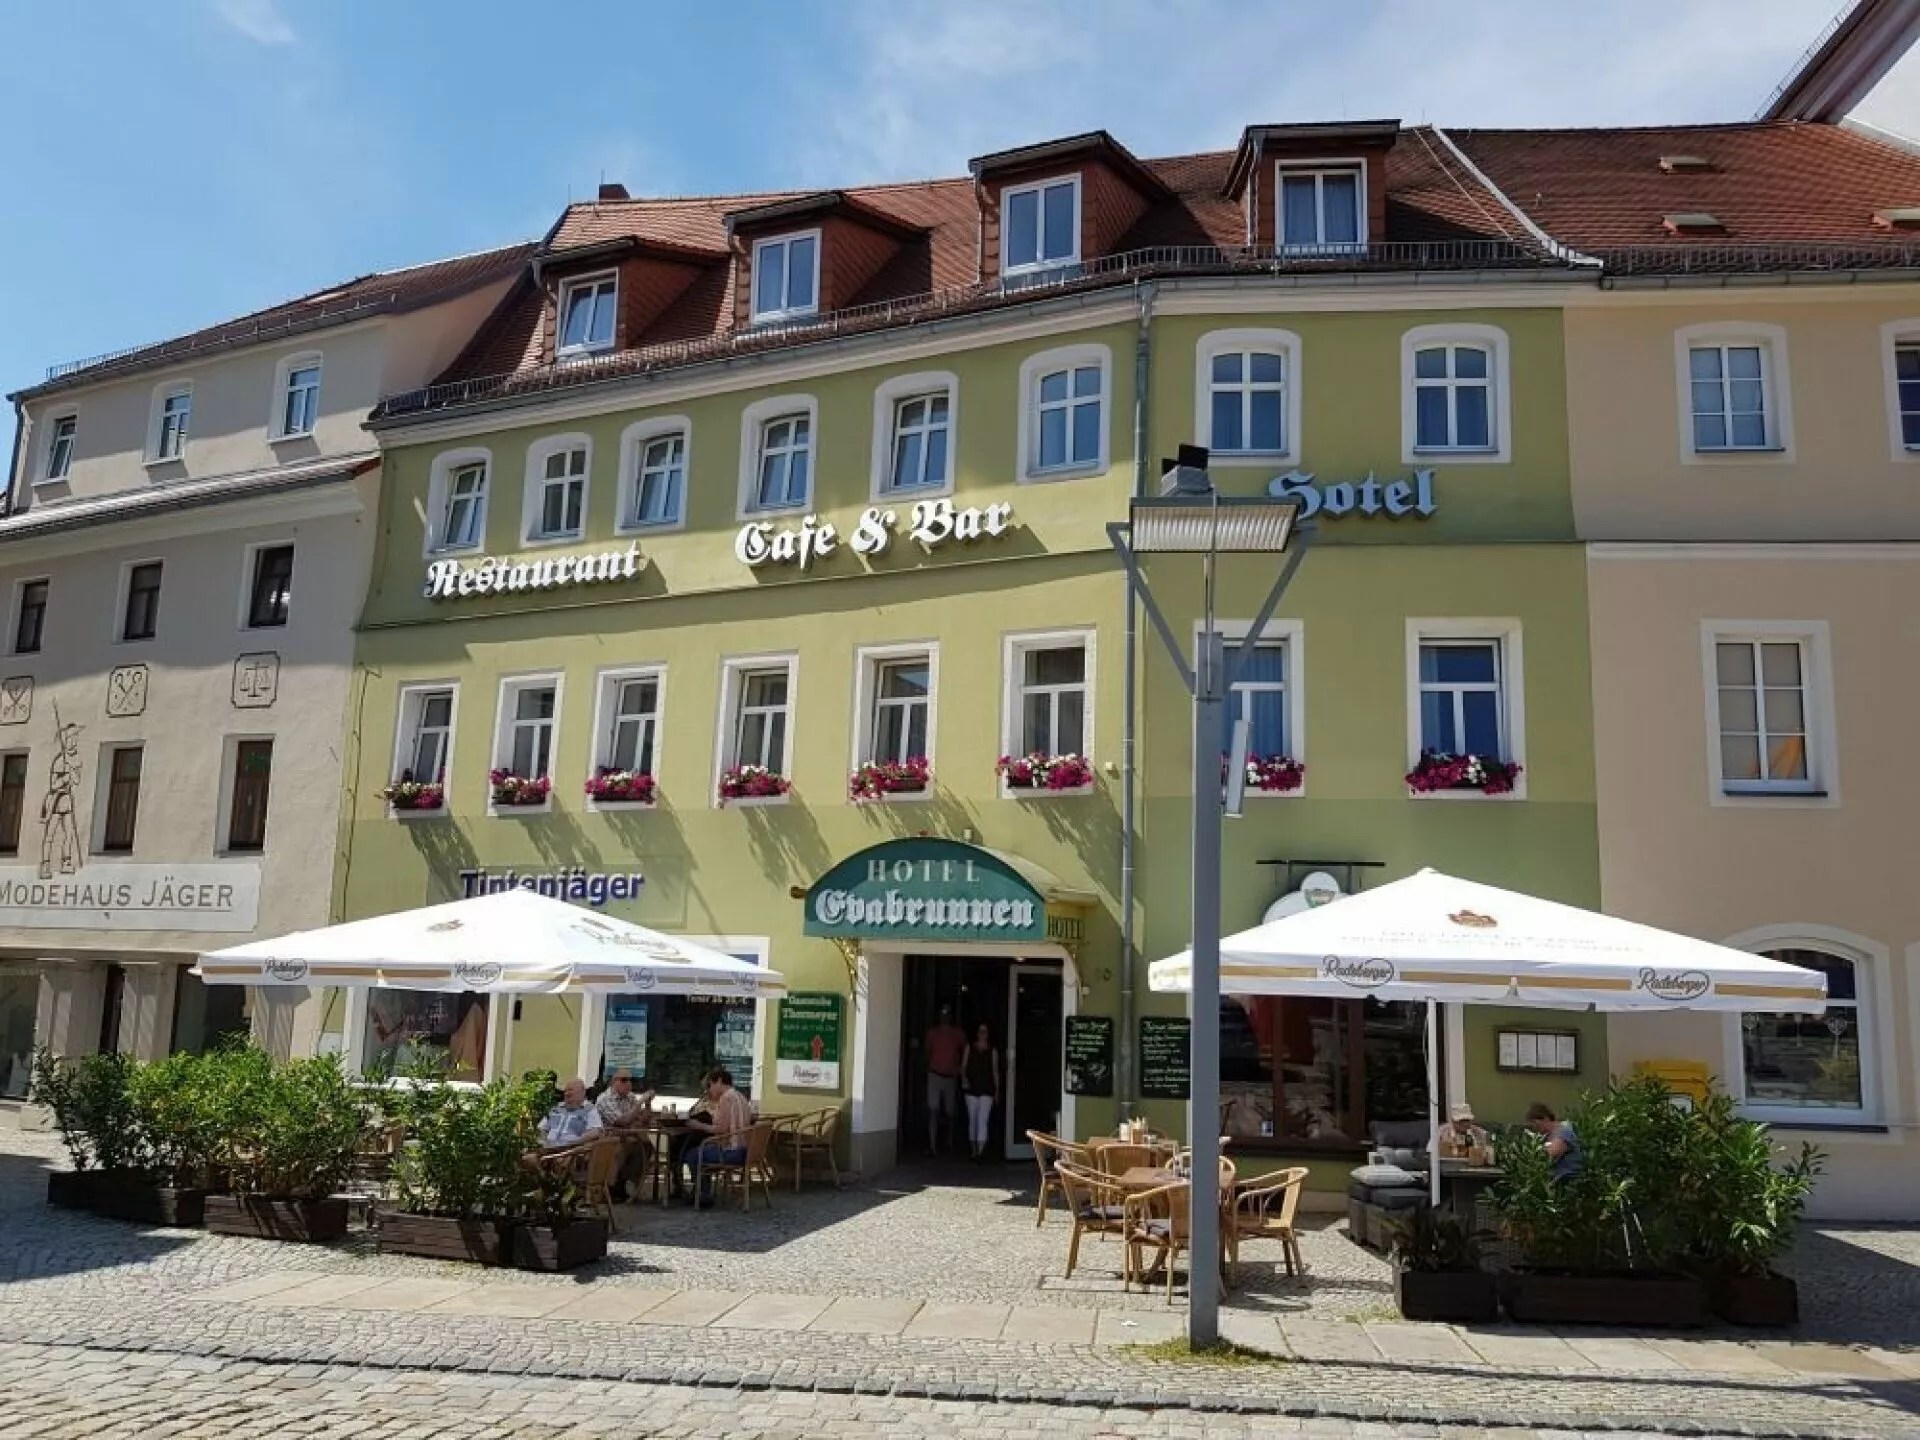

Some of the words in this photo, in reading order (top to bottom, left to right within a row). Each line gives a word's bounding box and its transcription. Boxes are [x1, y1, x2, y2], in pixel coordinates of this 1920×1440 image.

[850, 507, 896, 554] &
[910, 499, 1013, 544] Bar
[424, 539, 640, 598] Restaurant
[867, 859, 980, 882] HOTEL
[815, 888, 1034, 928] Evabrunnen
[1322, 955, 1394, 985] Radeberger
[1637, 967, 1710, 996] Radeberger
